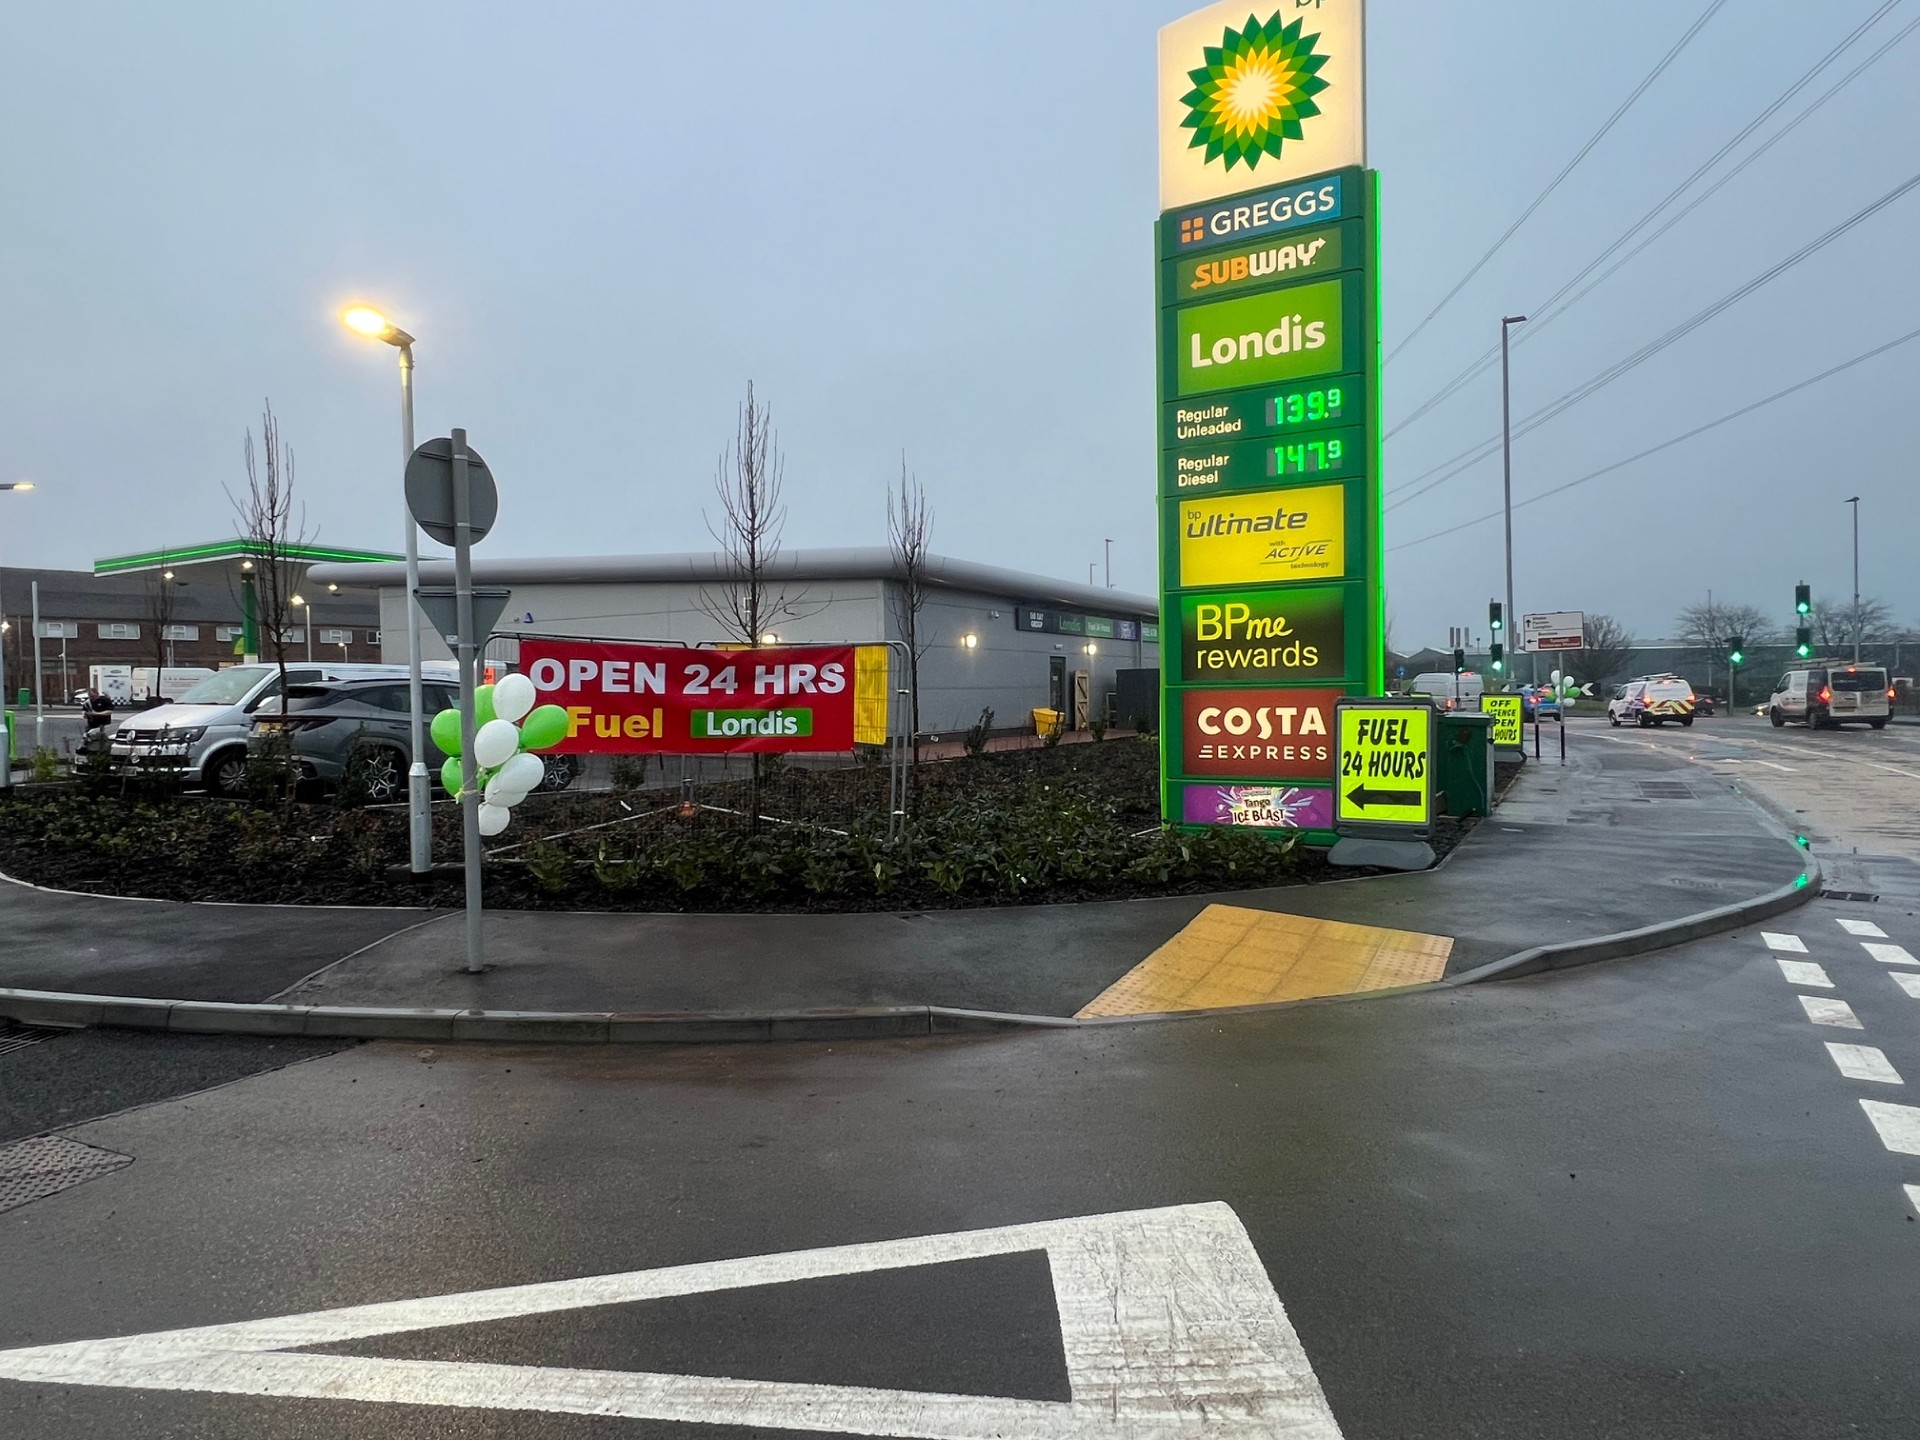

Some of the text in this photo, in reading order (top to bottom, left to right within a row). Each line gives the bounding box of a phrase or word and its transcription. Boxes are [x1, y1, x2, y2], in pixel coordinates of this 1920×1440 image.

[1210, 186, 1335, 235] GREGGS
[1190, 237, 1326, 290] SUBWAY
[1191, 313, 1326, 368] Londis
[1177, 405, 1229, 423] Regular
[1177, 419, 1242, 439] Unleaded
[1178, 454, 1230, 472] Regular
[1178, 471, 1219, 487] Diesel
[1187, 510, 1202, 521] bp
[1187, 508, 1308, 539] ultimate
[1265, 544, 1328, 559] ACTIVE
[1290, 561, 1329, 569] technology
[1197, 640, 1319, 669] rewards
[530, 658, 846, 695] OPEN 24 HRS
[566, 706, 663, 738] Fuel
[706, 709, 798, 736] Londis
[1197, 707, 1327, 740] COSTA
[1357, 718, 1410, 745] FUEL
[1494, 729, 1517, 741] HOURS
[1217, 745, 1327, 761] EXPRESS
[1342, 750, 1427, 780] 24 HOURS
[1233, 808, 1285, 823] ICE BLAST
[1244, 799, 1271, 809] Tango
